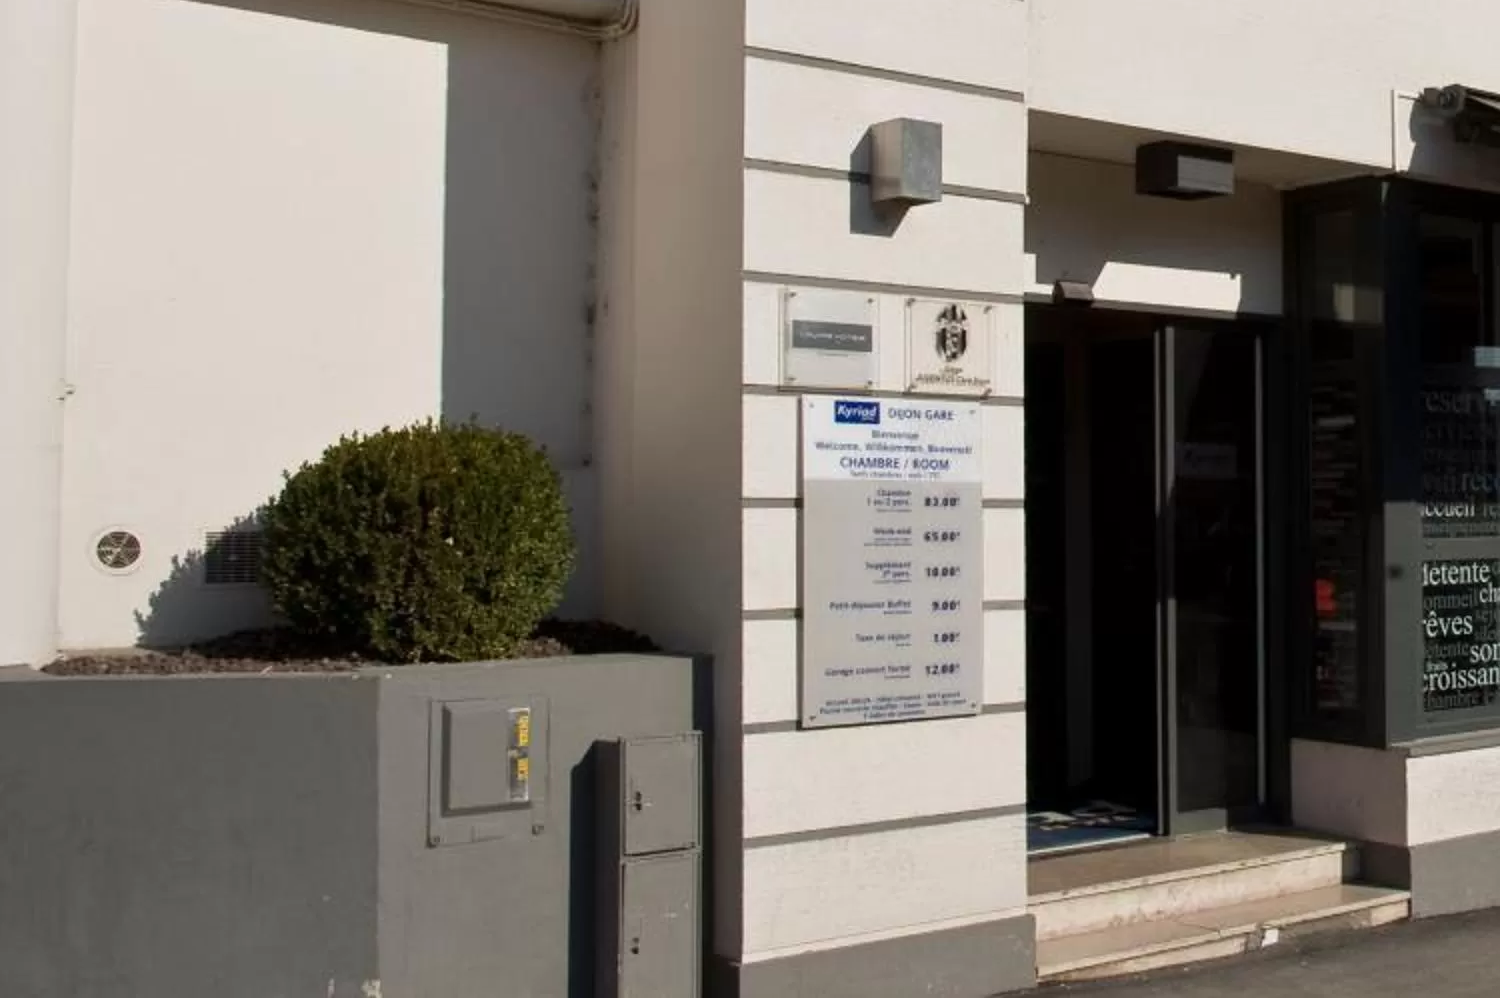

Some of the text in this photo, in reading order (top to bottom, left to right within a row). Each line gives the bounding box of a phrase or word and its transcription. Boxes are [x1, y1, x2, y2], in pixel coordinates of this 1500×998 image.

[837, 403, 878, 419] Kyriad
[924, 409, 955, 421] GARE
[839, 457, 900, 469] CHAMBRE
[912, 458, 950, 470] ROOM
